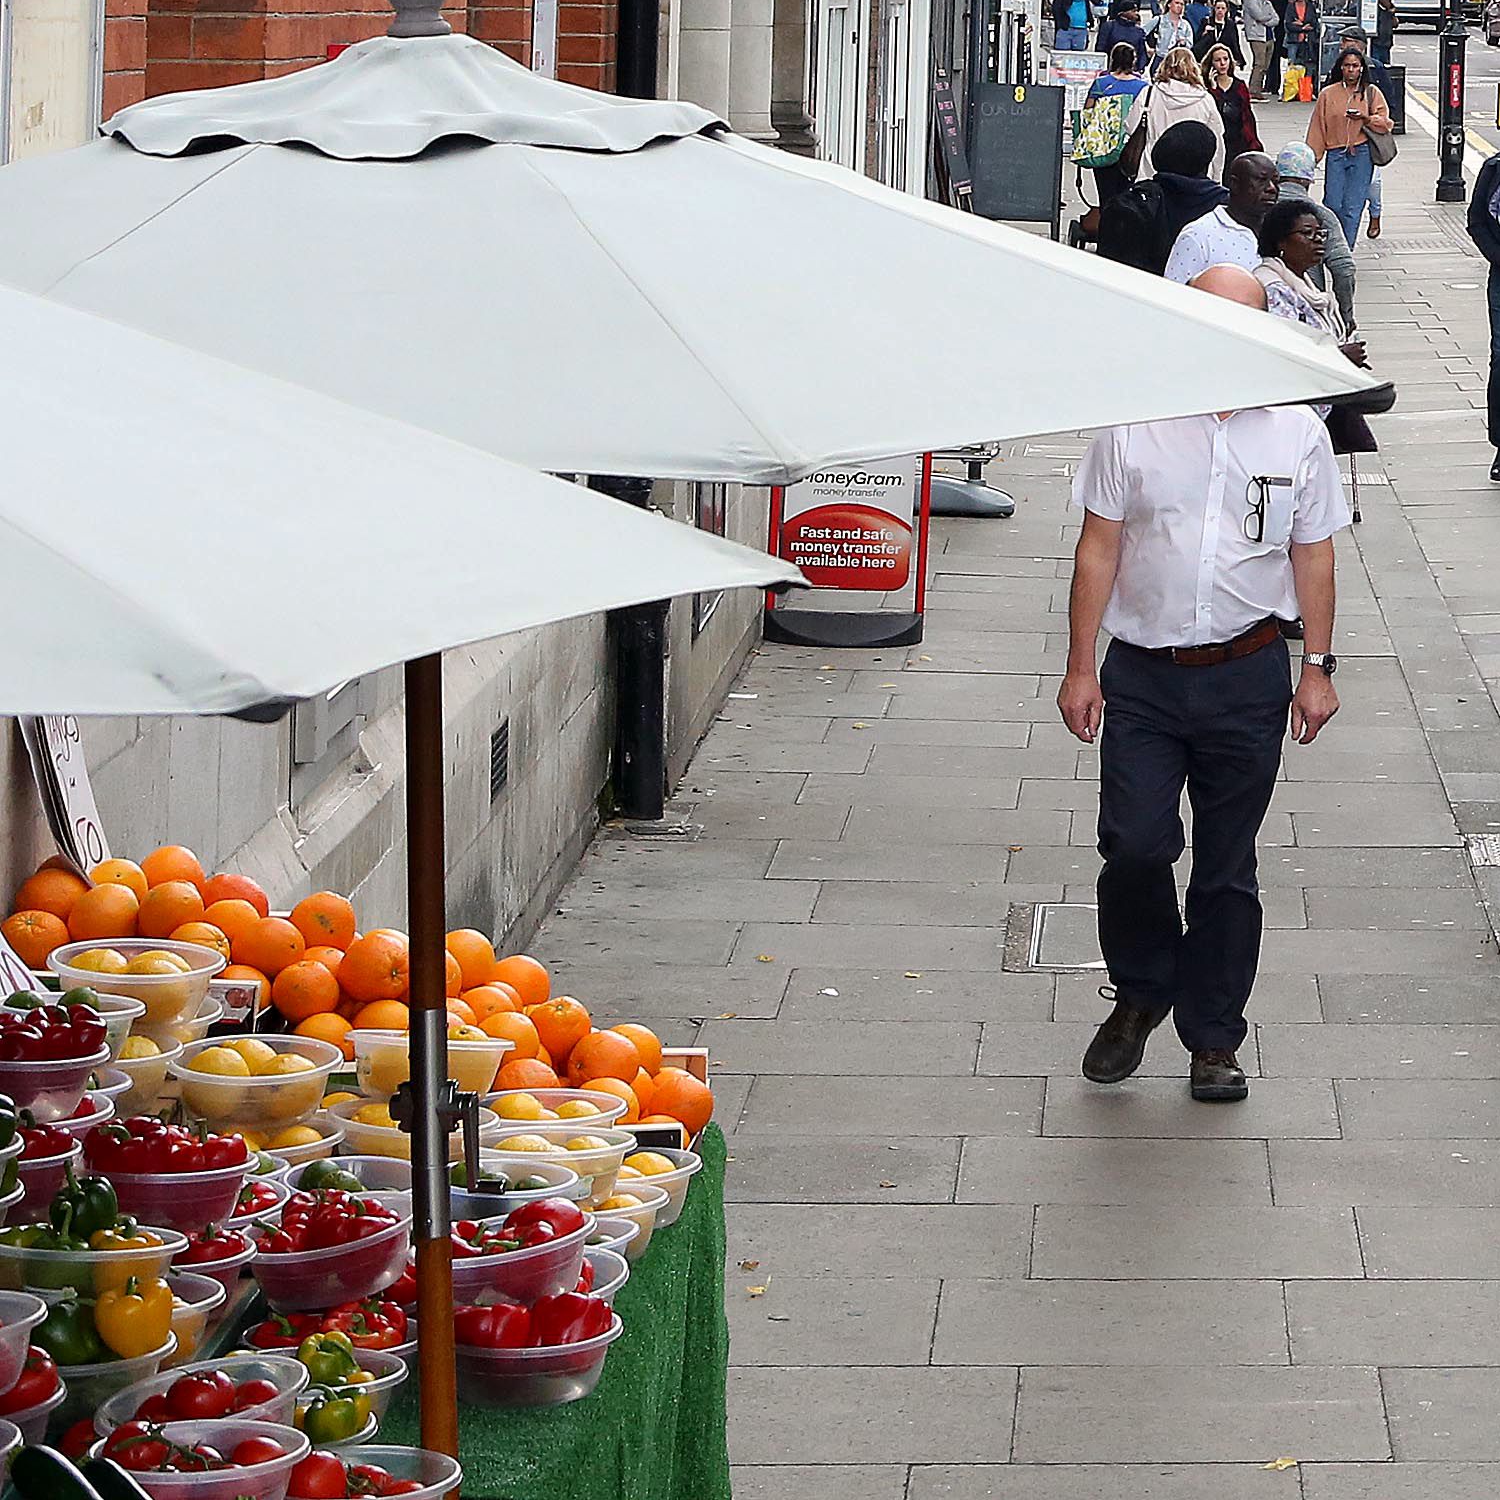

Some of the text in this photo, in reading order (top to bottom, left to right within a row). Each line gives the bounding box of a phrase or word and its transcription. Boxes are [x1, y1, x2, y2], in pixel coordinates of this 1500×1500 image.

[812, 487, 886, 499] money transfer
[799, 526, 894, 541] Fast and safe
[790, 542, 902, 555] money transfer
[795, 554, 896, 569] available here
